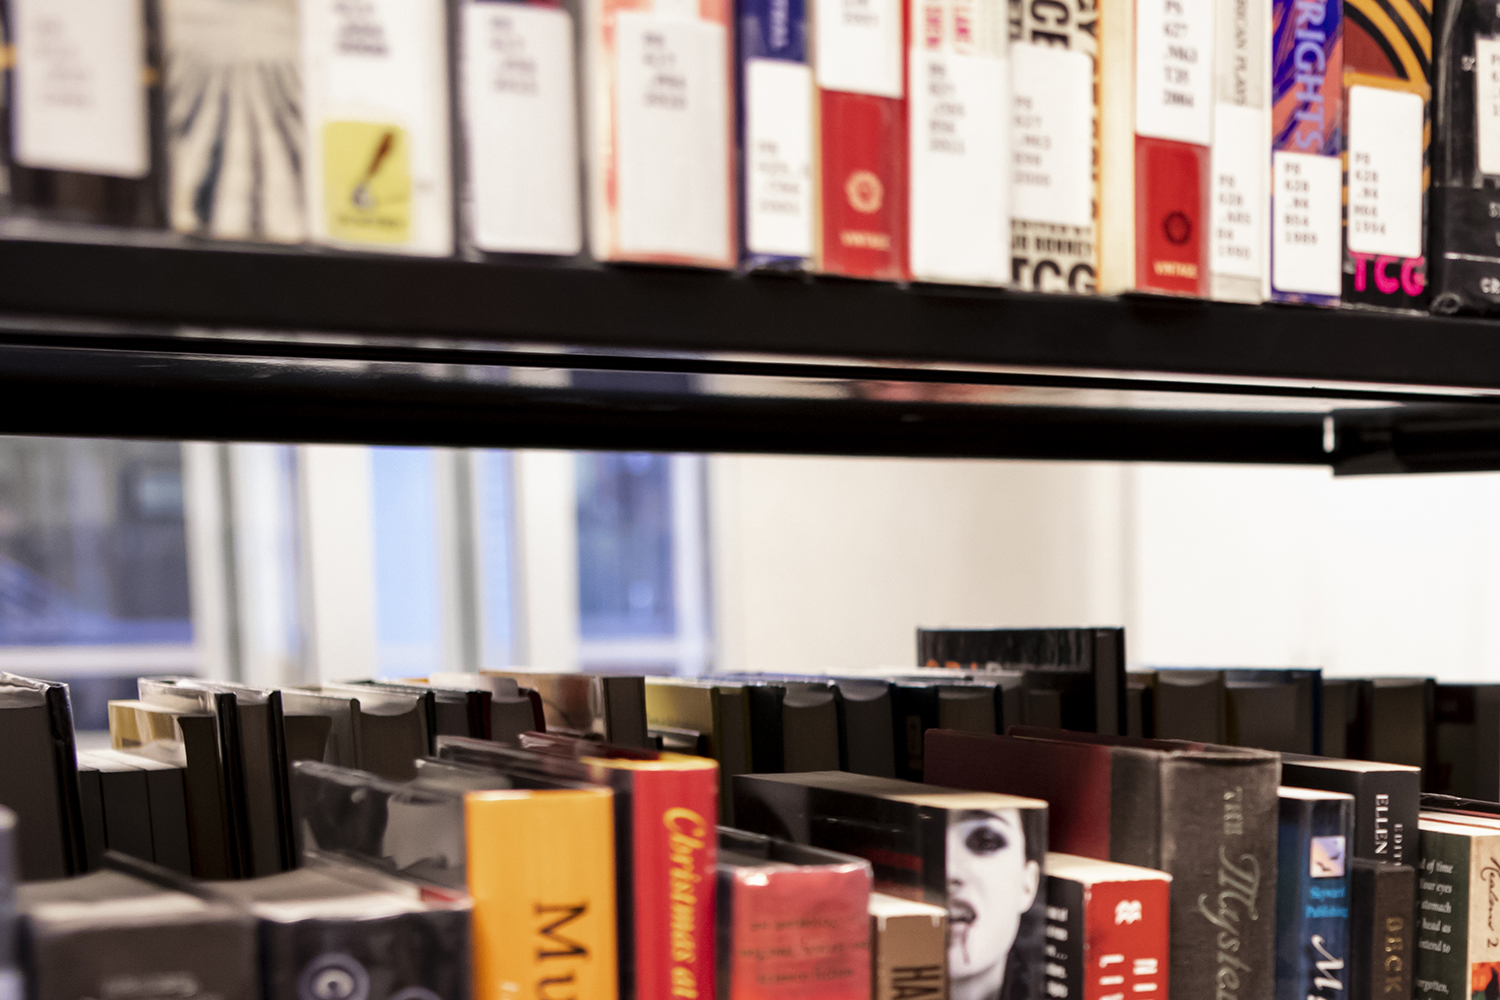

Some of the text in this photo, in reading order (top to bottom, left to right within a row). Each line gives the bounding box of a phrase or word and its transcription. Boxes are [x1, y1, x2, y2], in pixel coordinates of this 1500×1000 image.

[1375, 794, 1389, 854] ELLEN
[662, 806, 706, 963] Christmas
[1487, 937, 1499, 948] 2
[671, 966, 698, 1000] at
